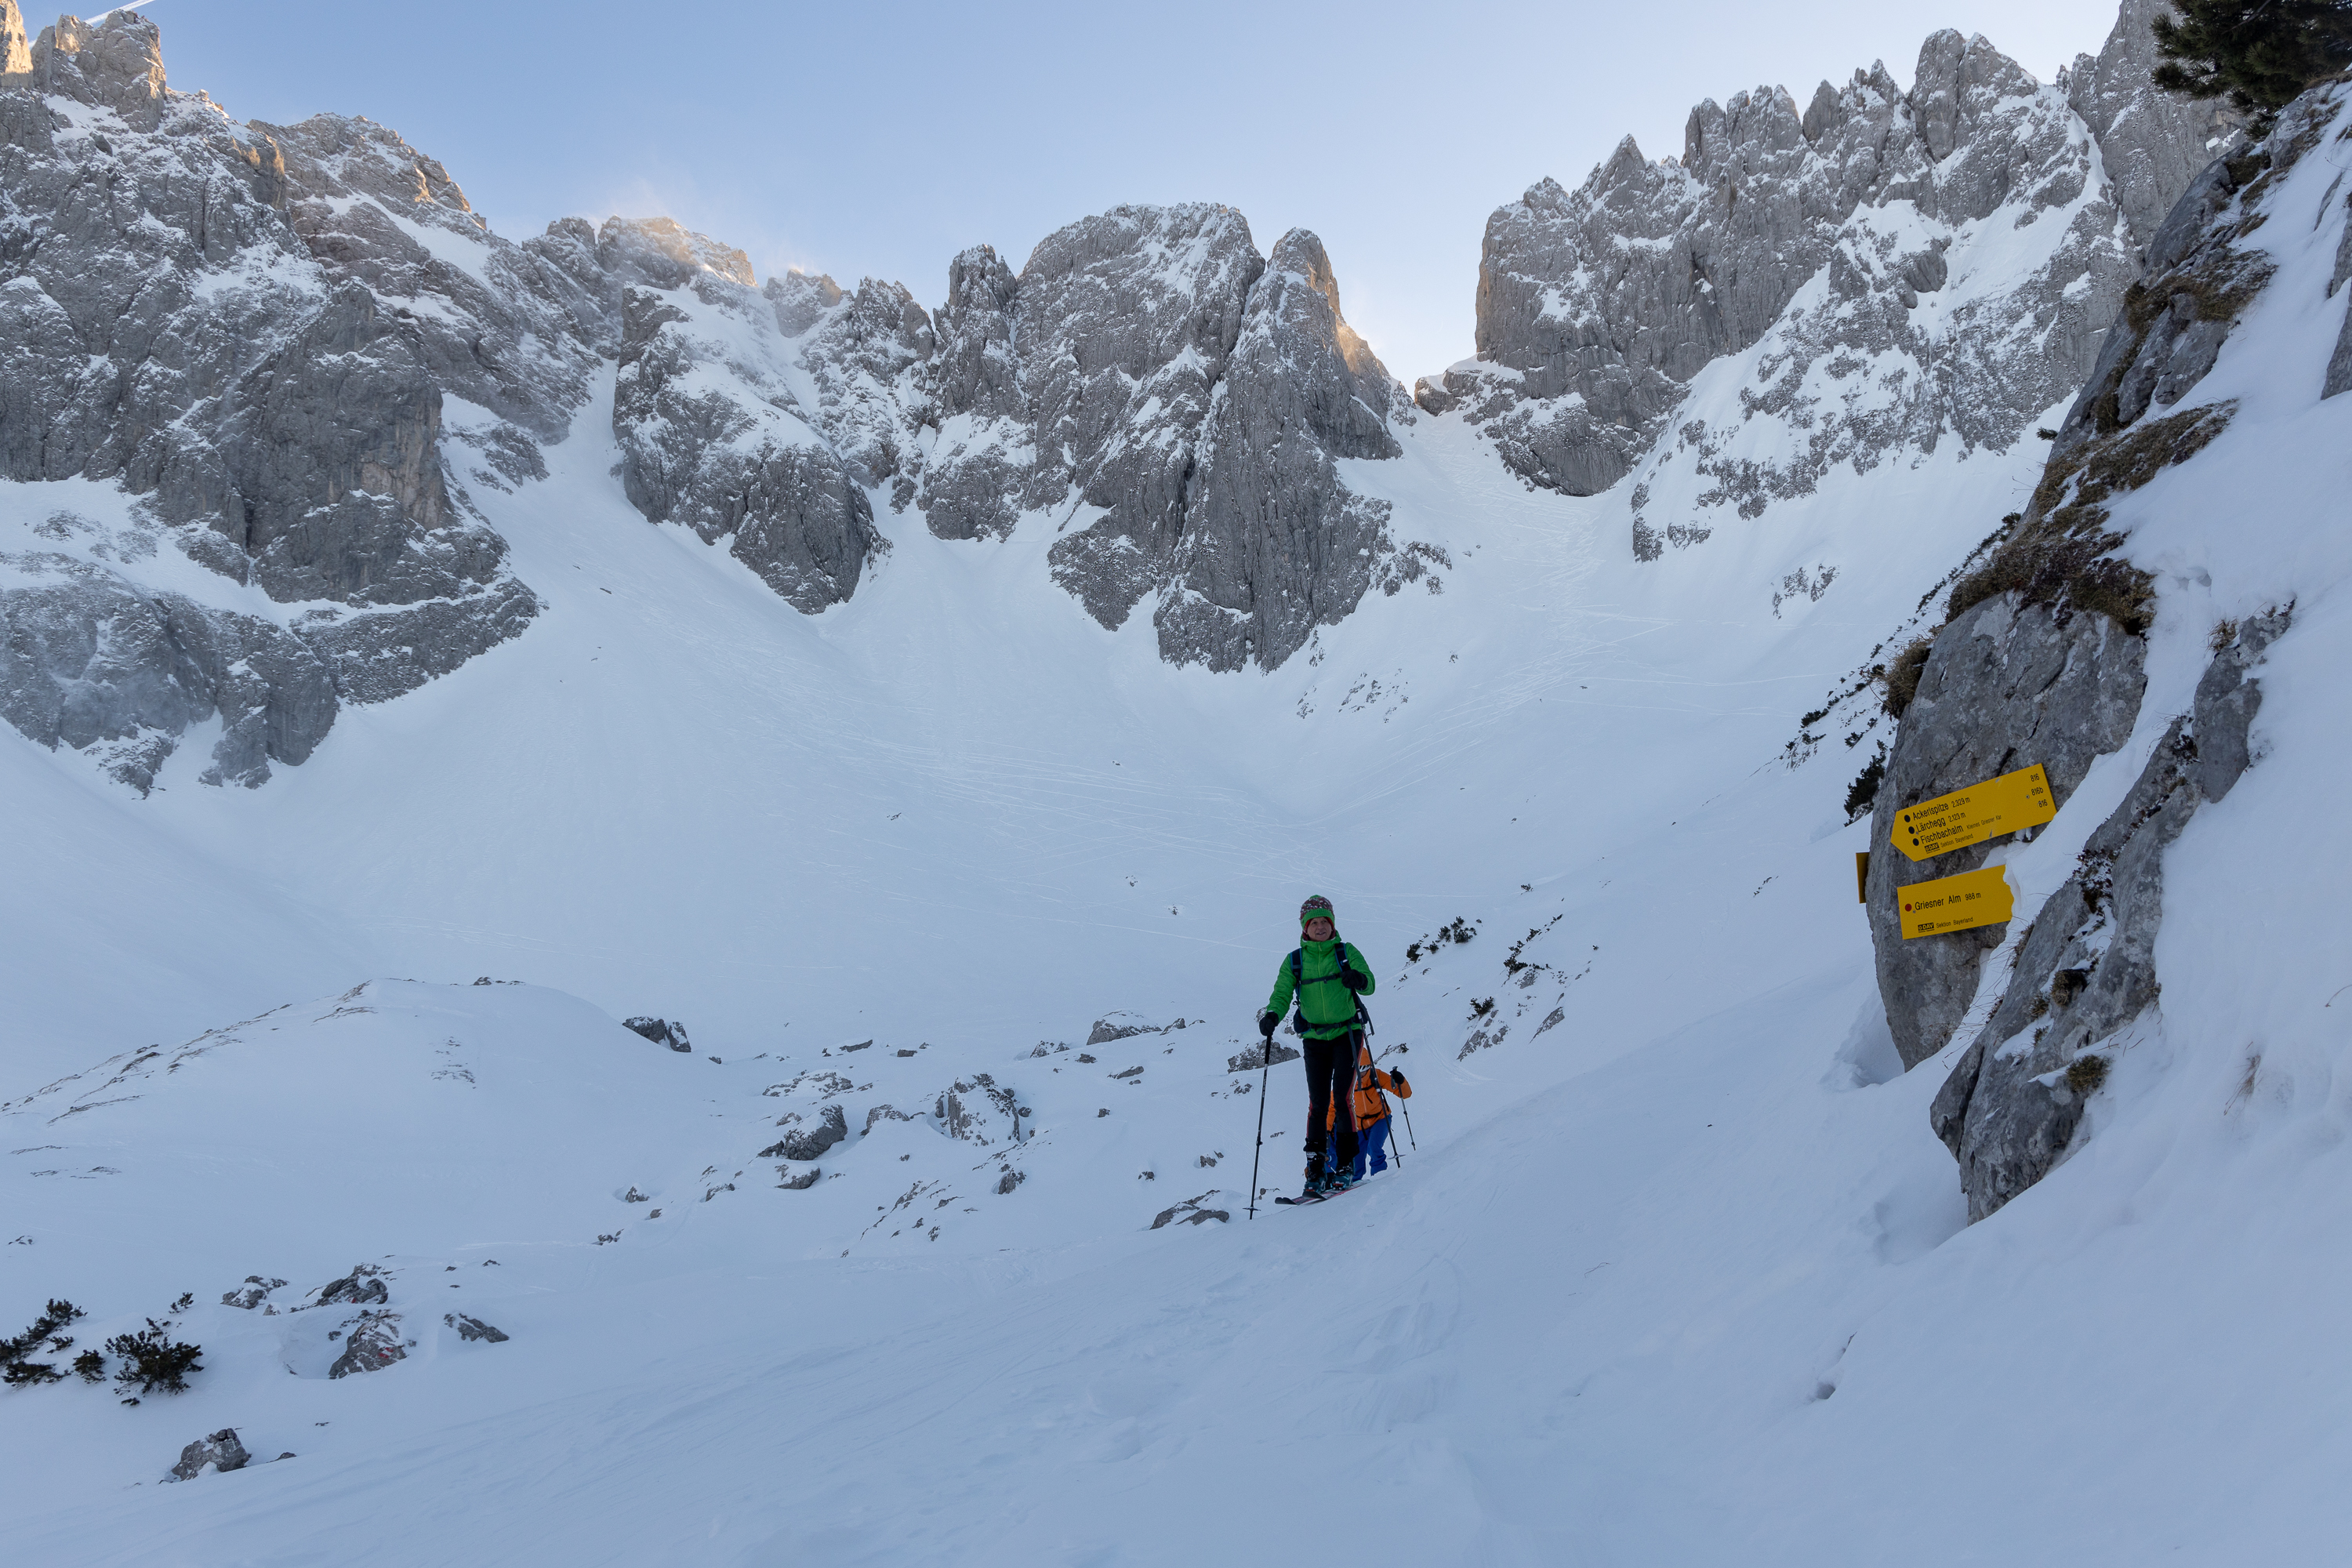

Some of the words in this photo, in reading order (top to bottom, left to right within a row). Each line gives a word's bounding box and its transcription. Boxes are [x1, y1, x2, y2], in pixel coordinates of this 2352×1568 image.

[2031, 773, 2039, 782] 816
[2031, 787, 2043, 796] 816b
[1913, 803, 1949, 820] Ackerlspitze
[1951, 798, 1965, 808] 2.329
[2038, 799, 2048, 808] 816
[1916, 818, 1946, 832] Lärchegg
[1948, 813, 1960, 822] 2.123
[1920, 825, 1963, 844] Fischbachalm
[1955, 834, 1973, 843] Bayerland
[1915, 898, 1944, 910] Griesner
[1948, 895, 1961, 904] Alm
